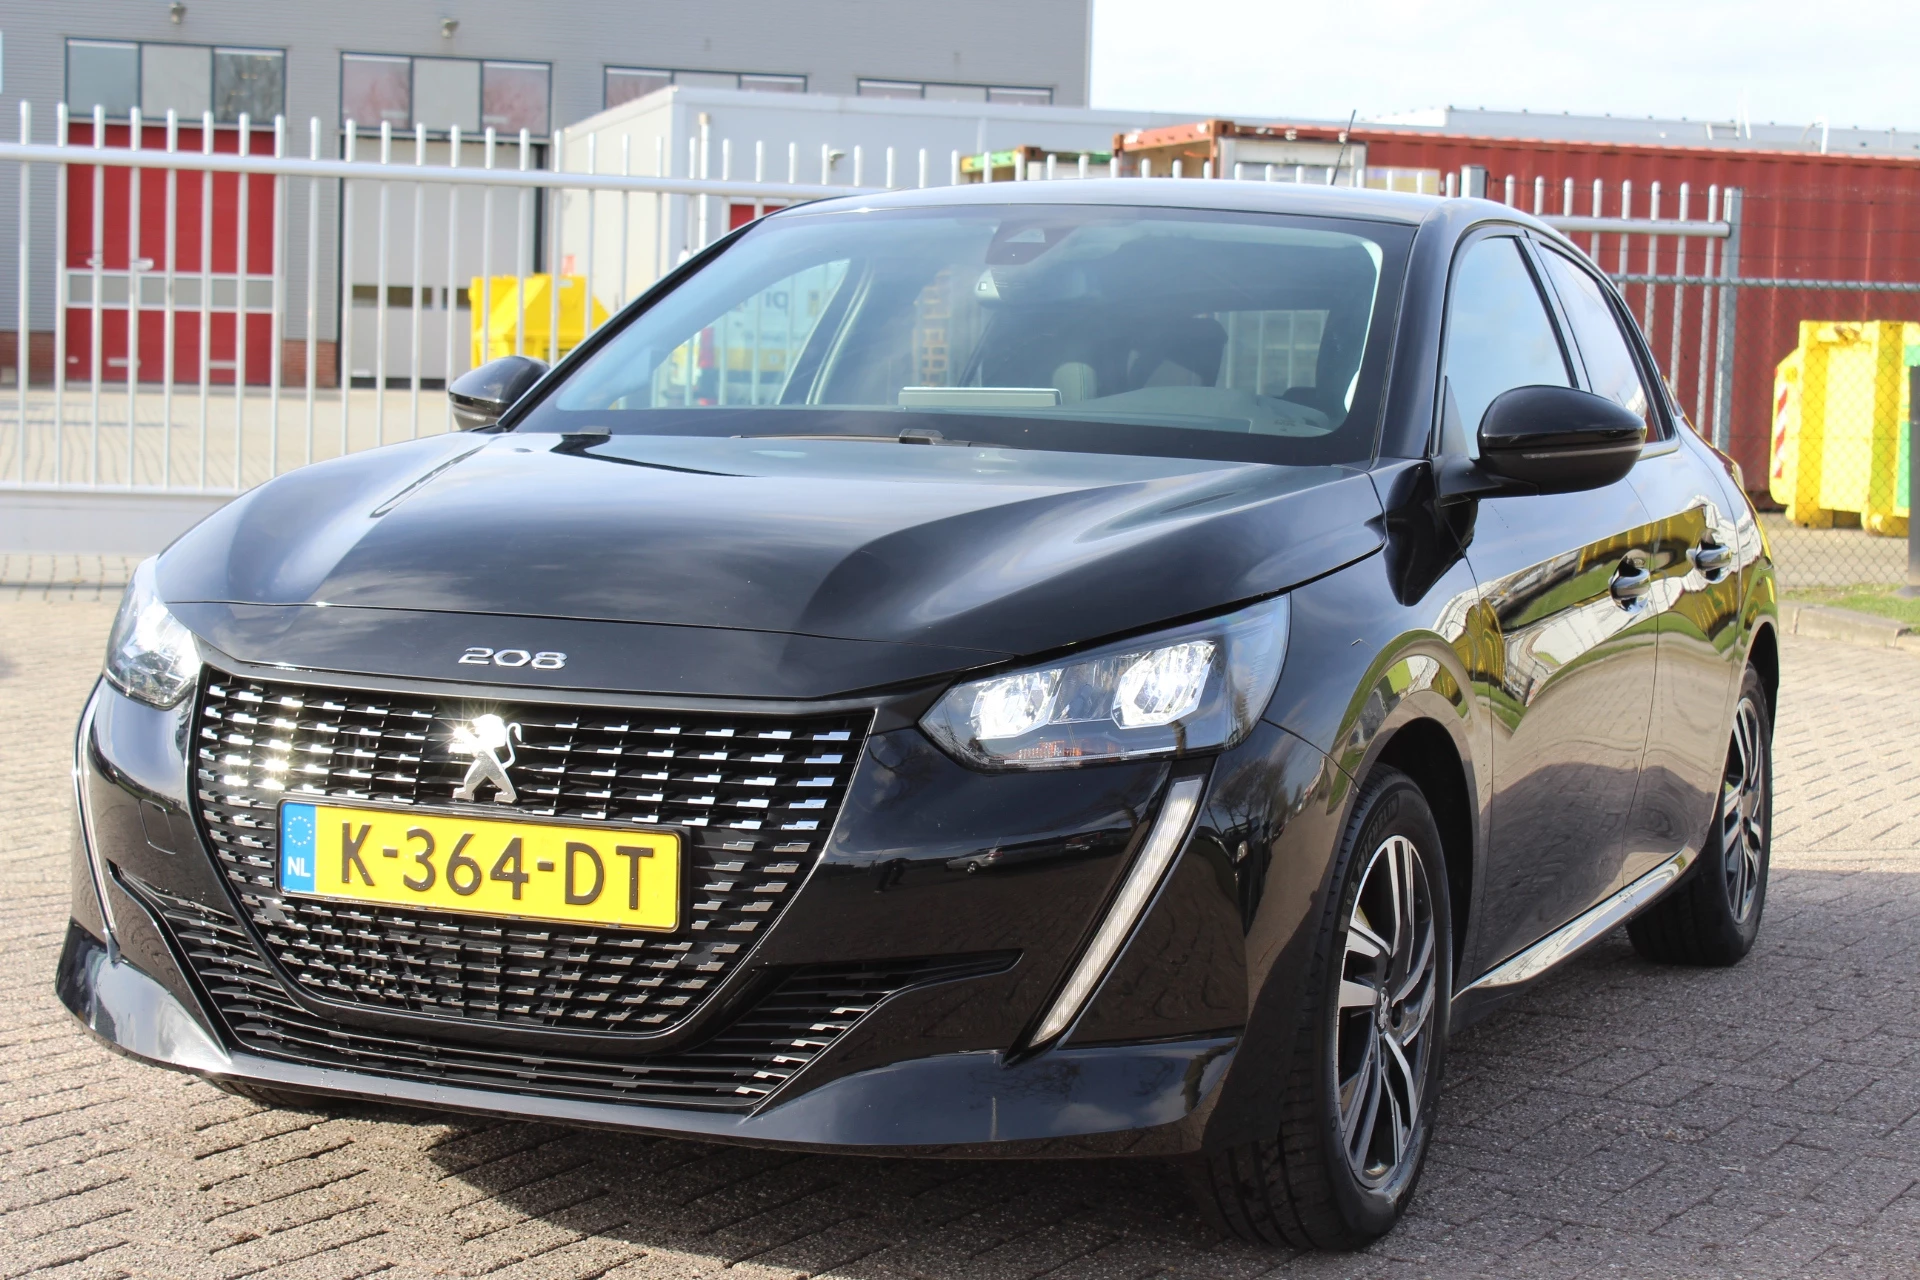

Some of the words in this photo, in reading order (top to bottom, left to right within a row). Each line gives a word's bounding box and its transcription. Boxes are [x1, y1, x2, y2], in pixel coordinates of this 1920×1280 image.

[458, 647, 567, 669] 208
[287, 856, 311, 878] NL
[341, 822, 654, 910] K-364-DT
